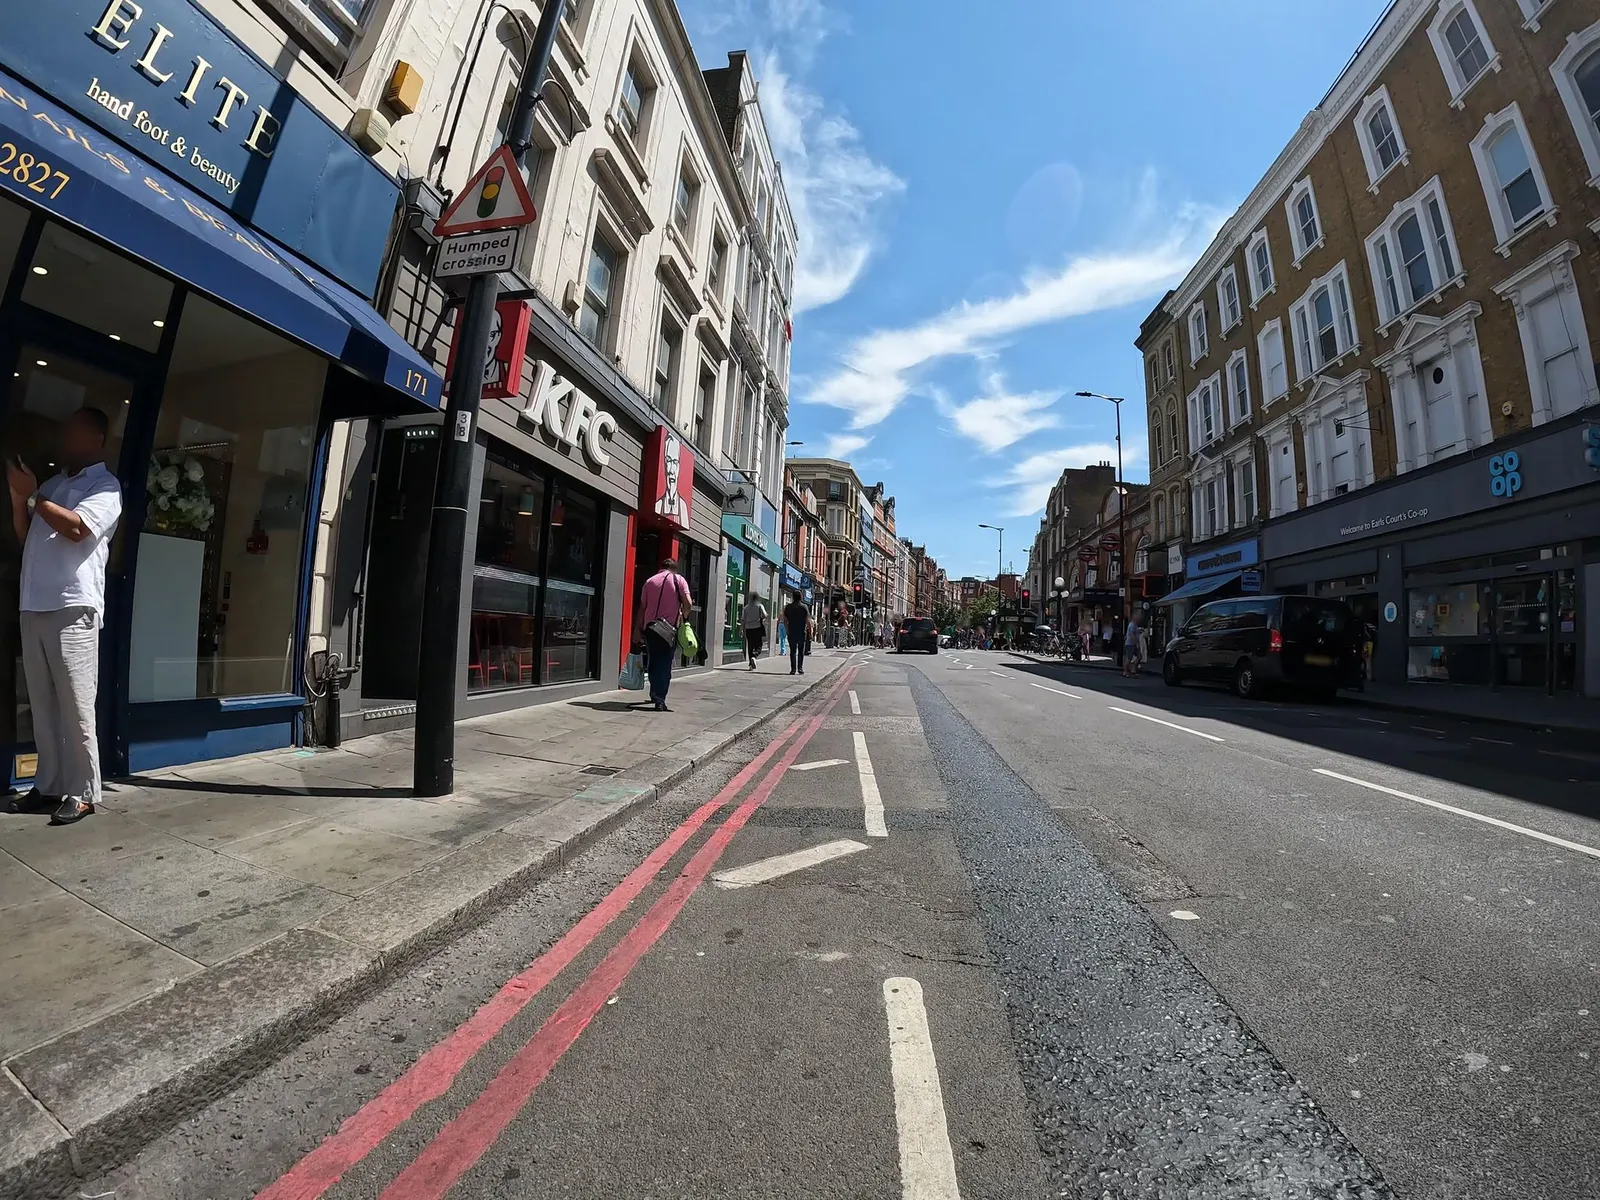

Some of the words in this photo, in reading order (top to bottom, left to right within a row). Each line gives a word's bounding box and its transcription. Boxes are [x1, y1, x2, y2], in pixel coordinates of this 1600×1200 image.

[91, 0, 281, 158] ELITE
[85, 78, 135, 121] hand
[132, 110, 170, 146] foot
[170, 137, 188, 158] &
[190, 147, 240, 194] beauty
[0, 142, 71, 200] 2827
[143, 176, 175, 201] &
[446, 235, 511, 255] Humped
[442, 253, 507, 271] crossing
[405, 369, 427, 396] 171
[460, 413, 467, 424] 3
[520, 359, 616, 467] KFC
[1340, 524, 1364, 536] Welcome
[1364, 522, 1371, 530] to
[1407, 507, 1429, 519] Co-op
